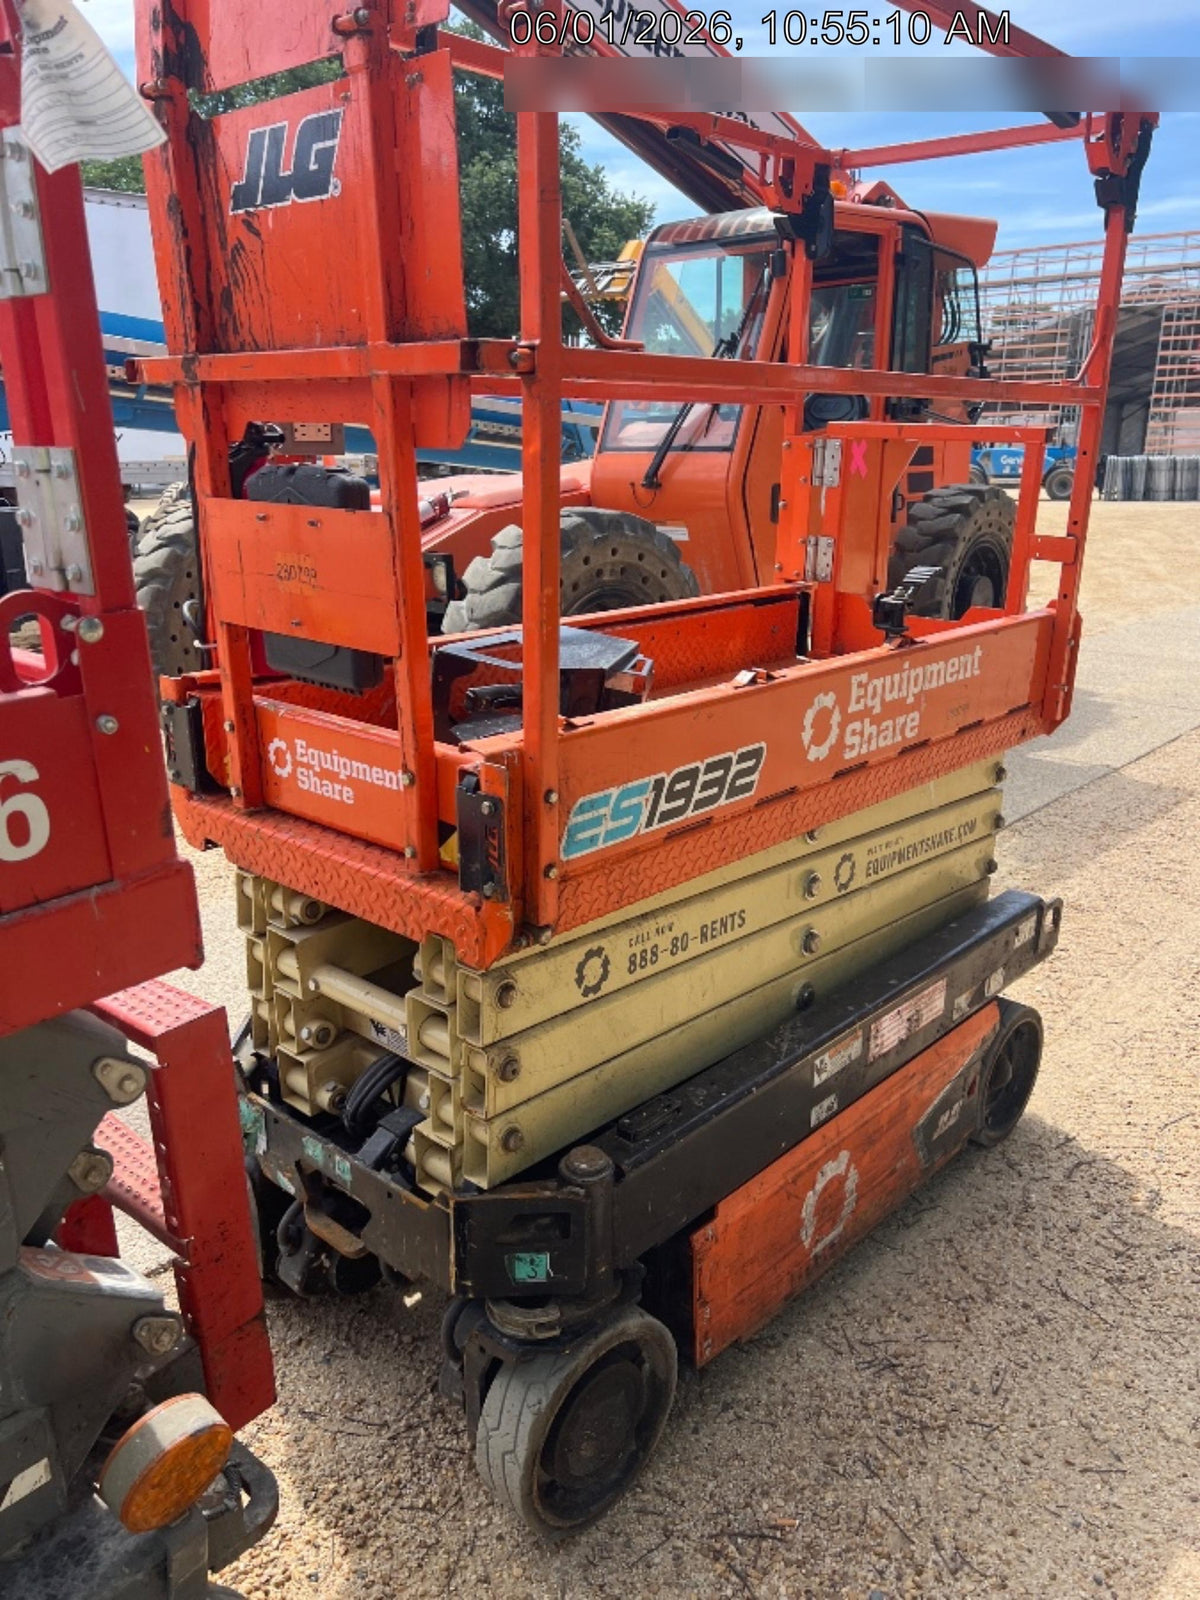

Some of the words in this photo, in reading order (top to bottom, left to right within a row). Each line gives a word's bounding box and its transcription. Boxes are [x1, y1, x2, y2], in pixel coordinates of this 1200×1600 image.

[229, 107, 344, 215] JLG
[848, 645, 982, 715] Equipment
[844, 710, 920, 760] Share
[296, 767, 354, 804] Share
[560, 741, 767, 861] ES1932
[627, 909, 747, 975] 888-80-RENTS
